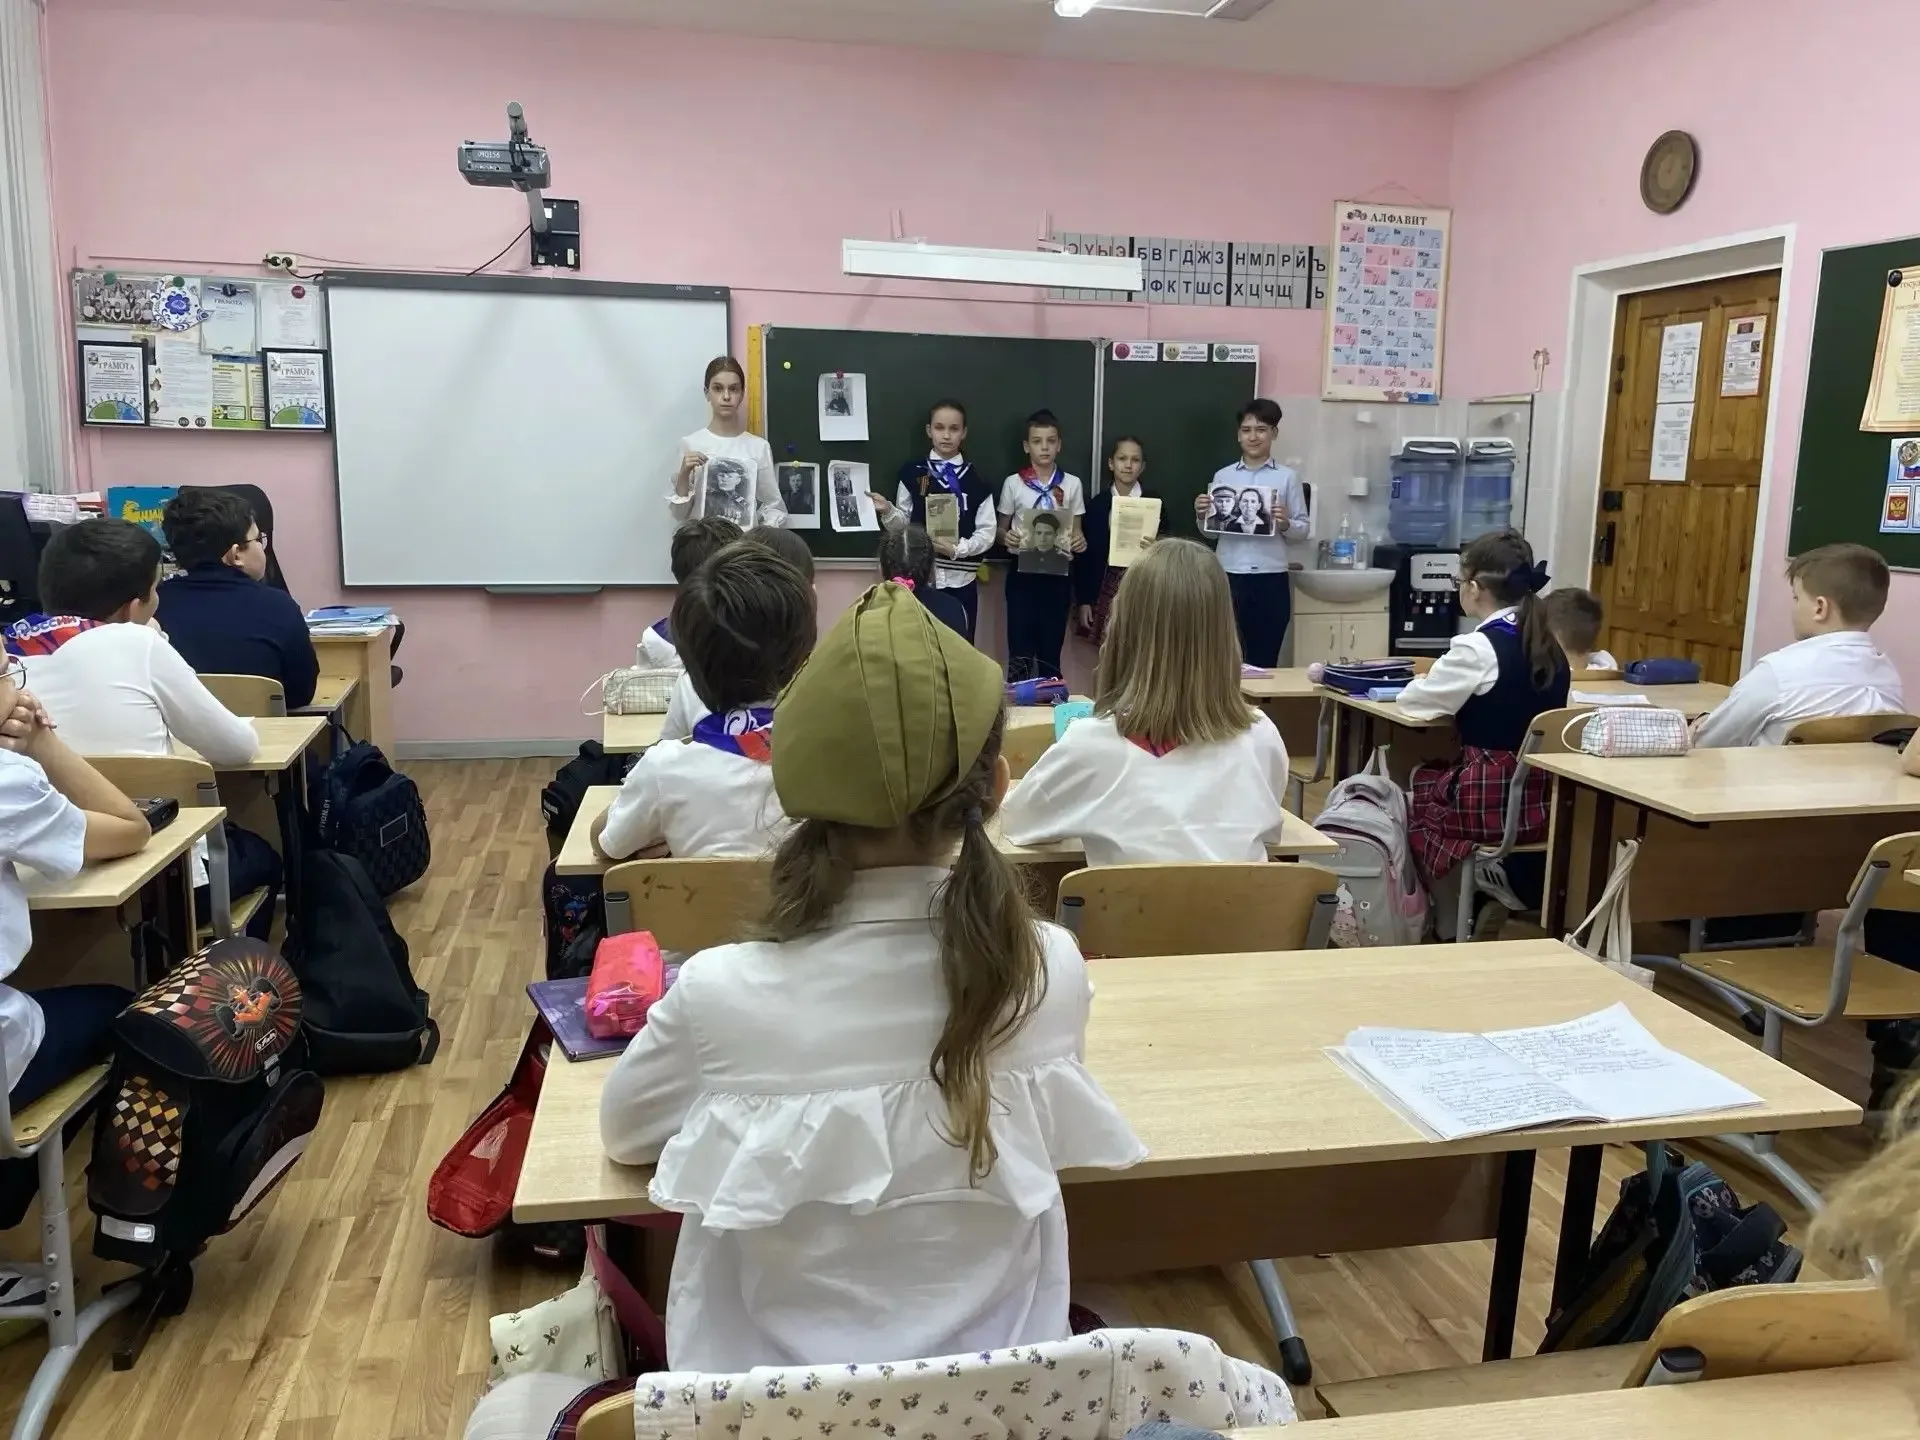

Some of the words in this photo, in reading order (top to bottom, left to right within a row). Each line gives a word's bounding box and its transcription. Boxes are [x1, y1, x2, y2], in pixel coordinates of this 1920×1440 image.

[1370, 213, 1427, 226] АЛФАВИТ
[99, 361, 135, 370] ГРАМОТА
[281, 367, 315, 376] ГРАМОТА
